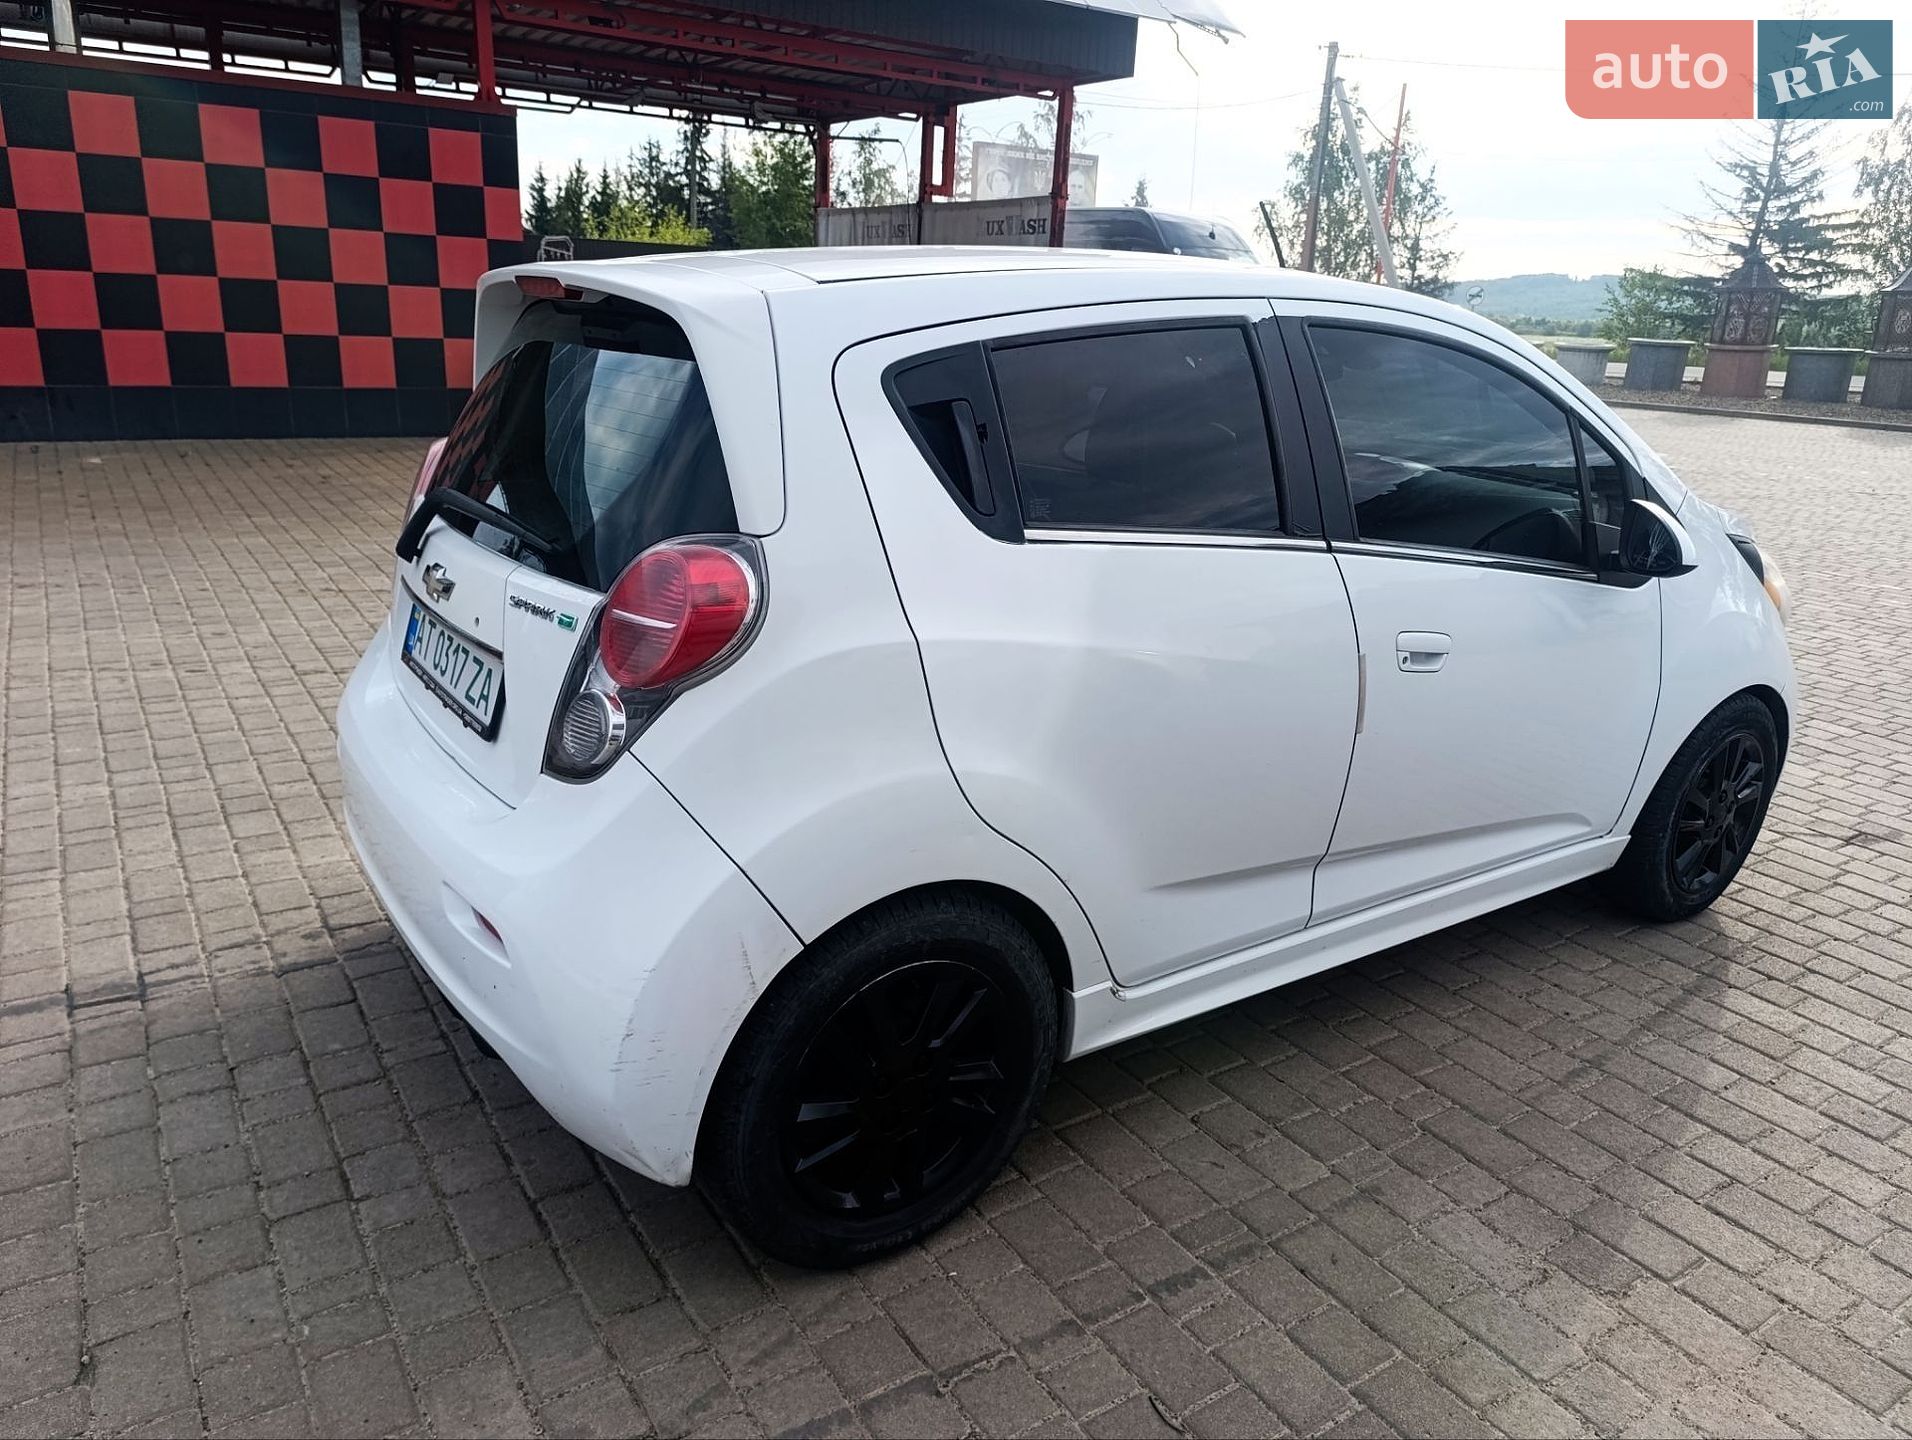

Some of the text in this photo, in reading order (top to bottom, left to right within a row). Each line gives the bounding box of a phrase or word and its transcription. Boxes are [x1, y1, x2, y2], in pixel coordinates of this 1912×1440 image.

[413, 614, 437, 660] AT
[433, 630, 470, 689] 0317
[465, 656, 492, 716] ZA
